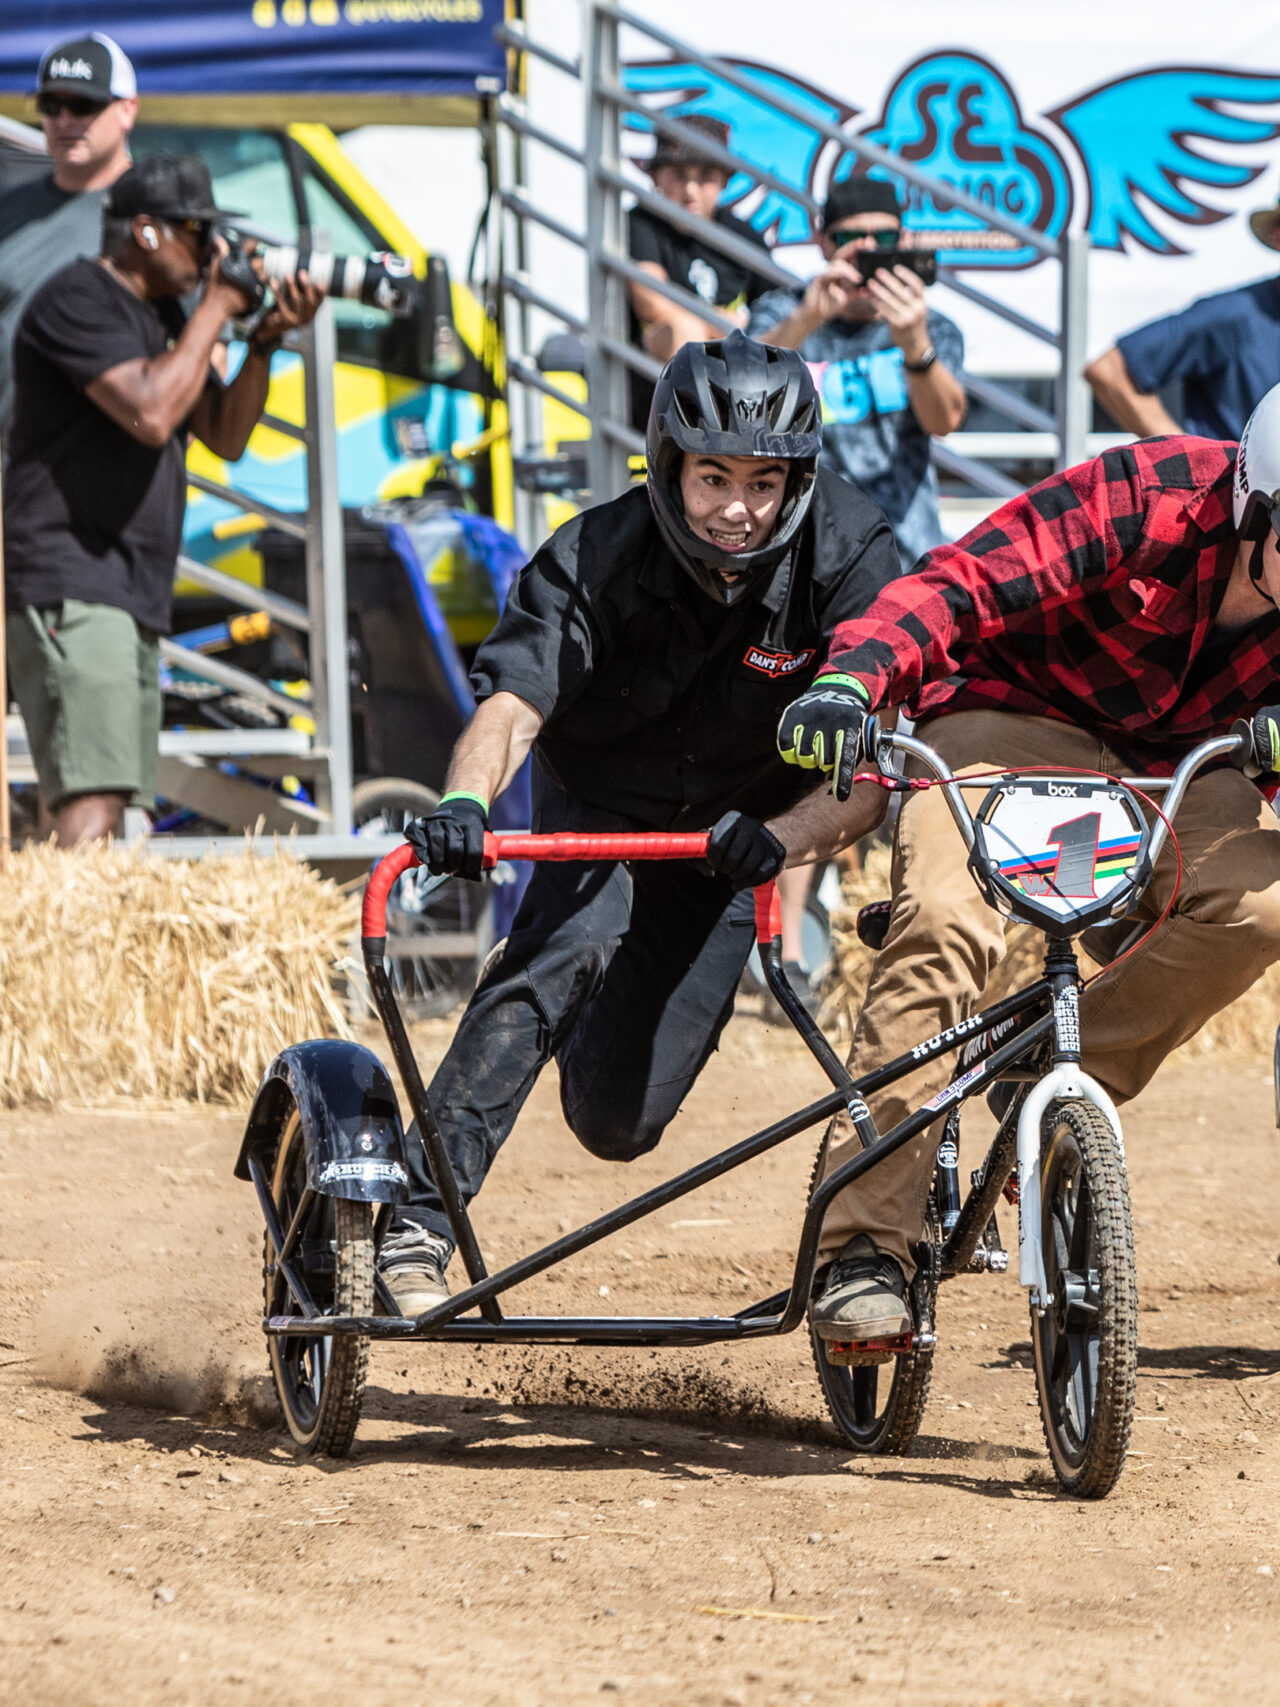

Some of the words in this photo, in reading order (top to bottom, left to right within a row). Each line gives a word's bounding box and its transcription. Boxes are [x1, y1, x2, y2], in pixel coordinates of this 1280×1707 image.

[900, 83, 1005, 163] SE
[749, 652, 778, 670] DAN'S
[781, 653, 808, 672] COMP
[1047, 782, 1078, 797] box
[911, 1013, 983, 1060] HUTCH
